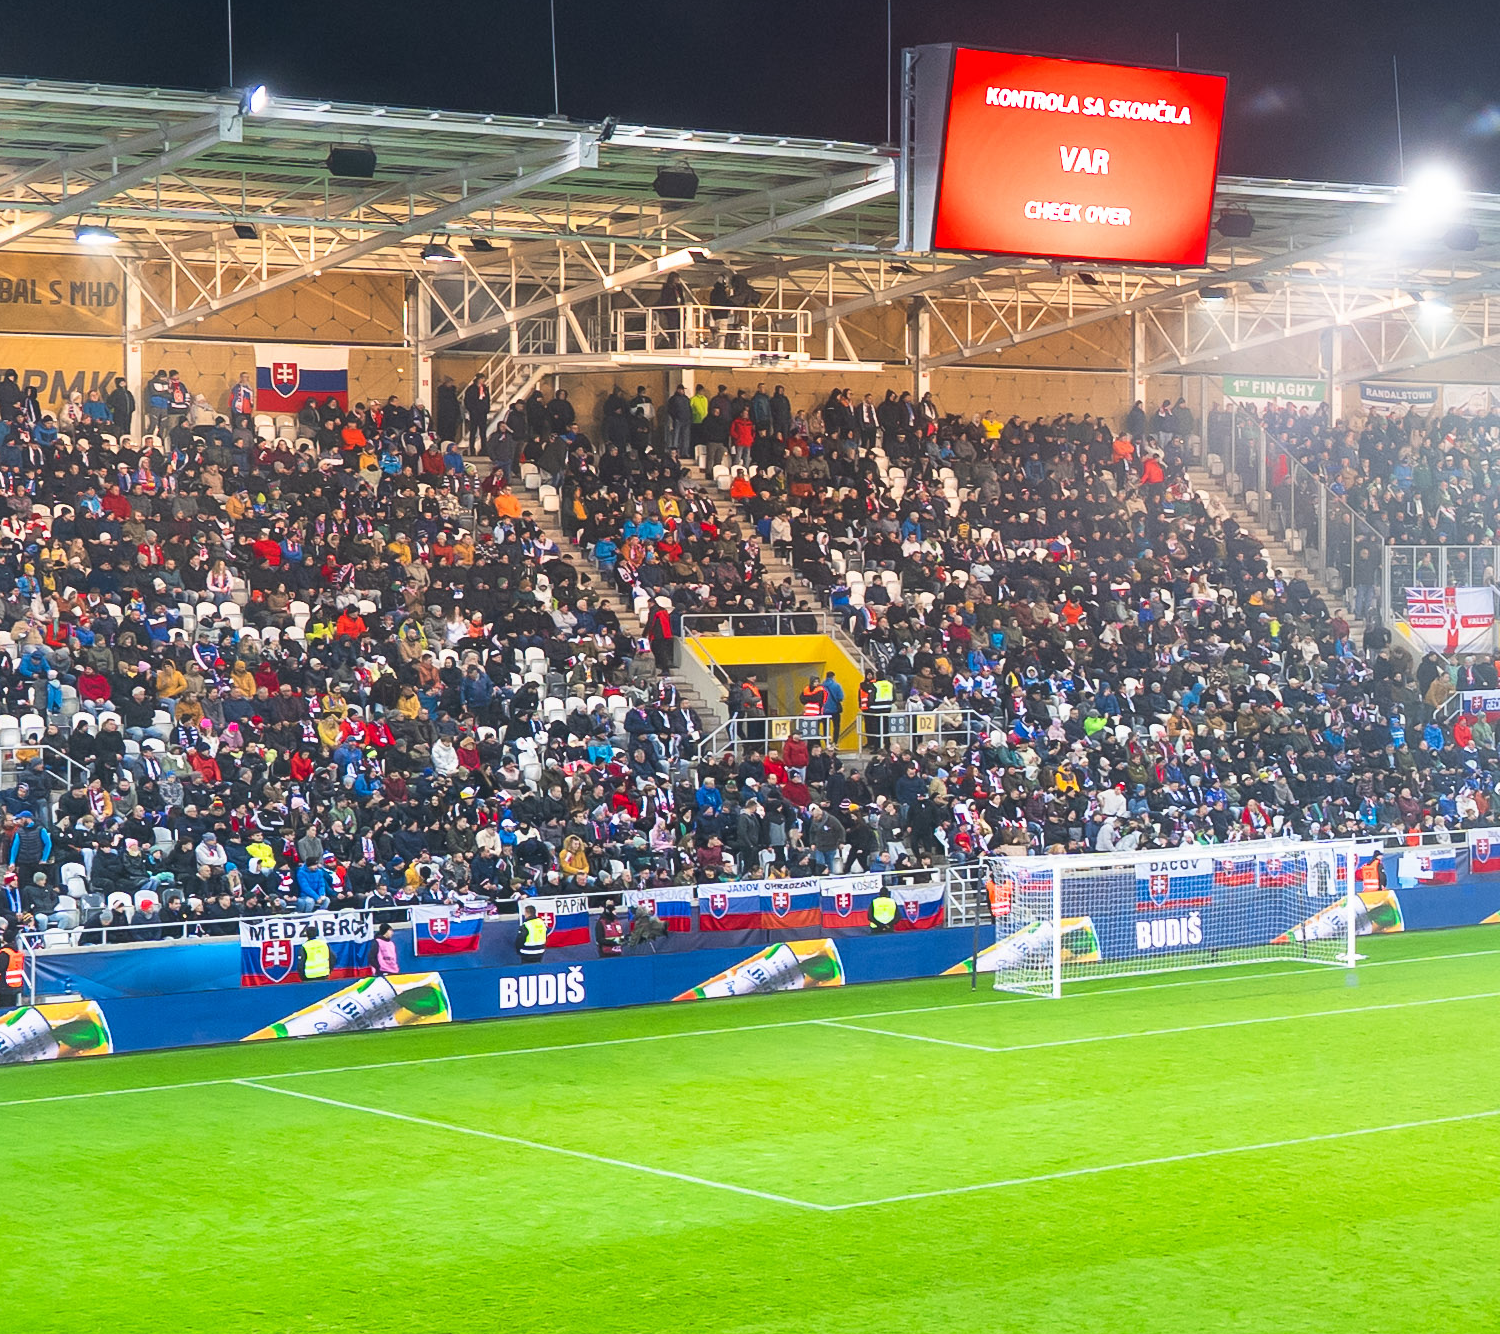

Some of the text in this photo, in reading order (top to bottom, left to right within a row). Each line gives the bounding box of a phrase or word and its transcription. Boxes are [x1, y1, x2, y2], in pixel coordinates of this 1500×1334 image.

[985, 87, 1192, 125] KONTROLA SA SKONČILA
[1059, 145, 1110, 175] VAR
[1024, 200, 1131, 226] CHECK OVER
[49, 280, 63, 305] S
[69, 281, 120, 307] MHD
[1467, 617, 1493, 625] VALLEY
[775, 723, 787, 734] D3
[920, 715, 932, 725] D2
[726, 883, 759, 894] JANOV
[1136, 912, 1203, 949] BUDIŠ
[499, 966, 585, 1009] BUDIŠ
